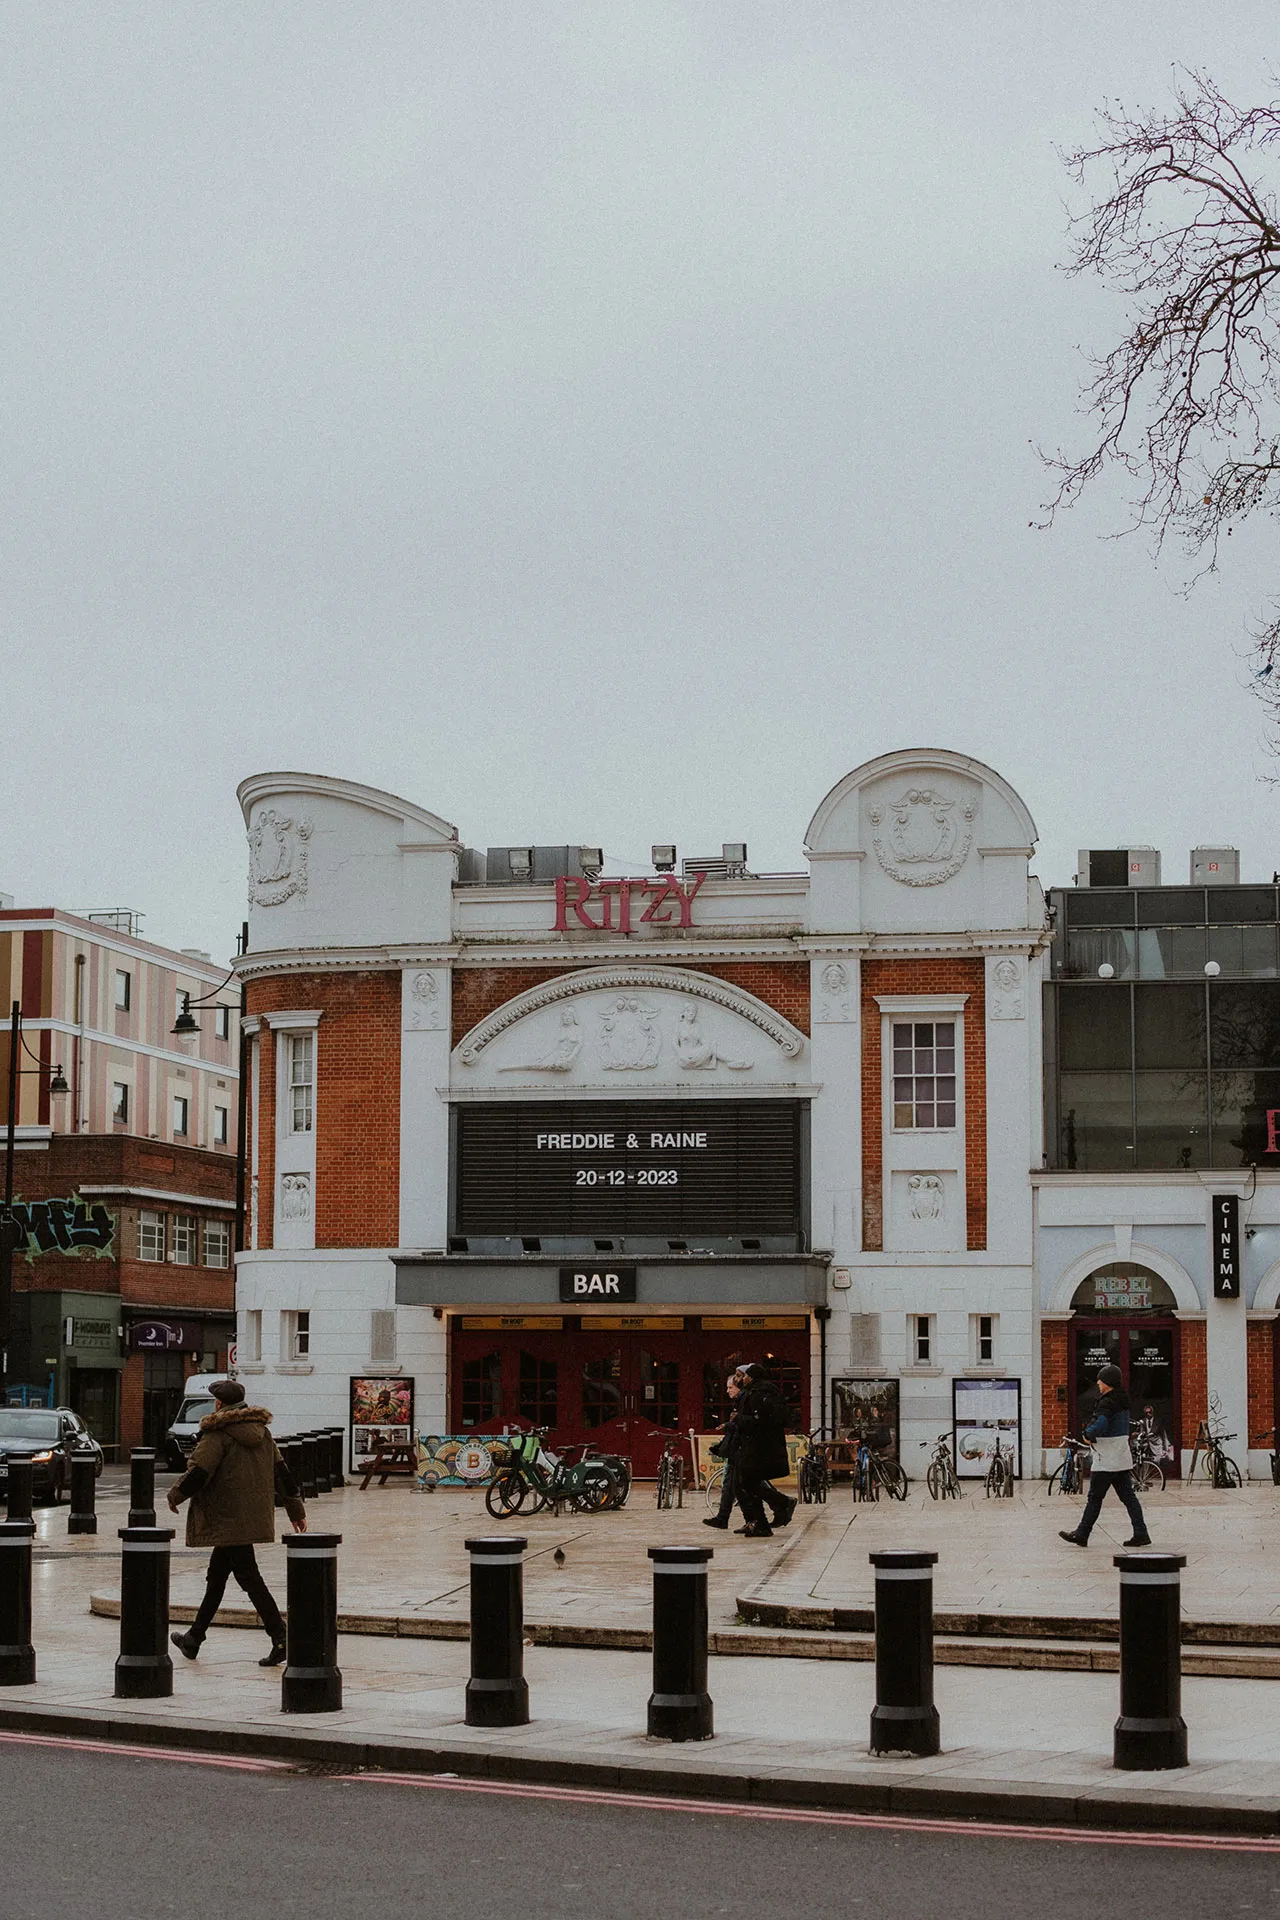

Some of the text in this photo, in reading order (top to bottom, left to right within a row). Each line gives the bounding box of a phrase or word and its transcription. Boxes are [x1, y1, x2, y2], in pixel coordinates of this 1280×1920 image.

[537, 1133, 707, 1149] FREDDIE & RAINE
[576, 1170, 678, 1185] 20-12-2023
[1219, 1202, 1233, 1290] CINEMA
[574, 1274, 620, 1294] BAR
[1094, 1277, 1152, 1293] REBEL
[1094, 1293, 1152, 1309] REBEL
[467, 1453, 480, 1468] B
